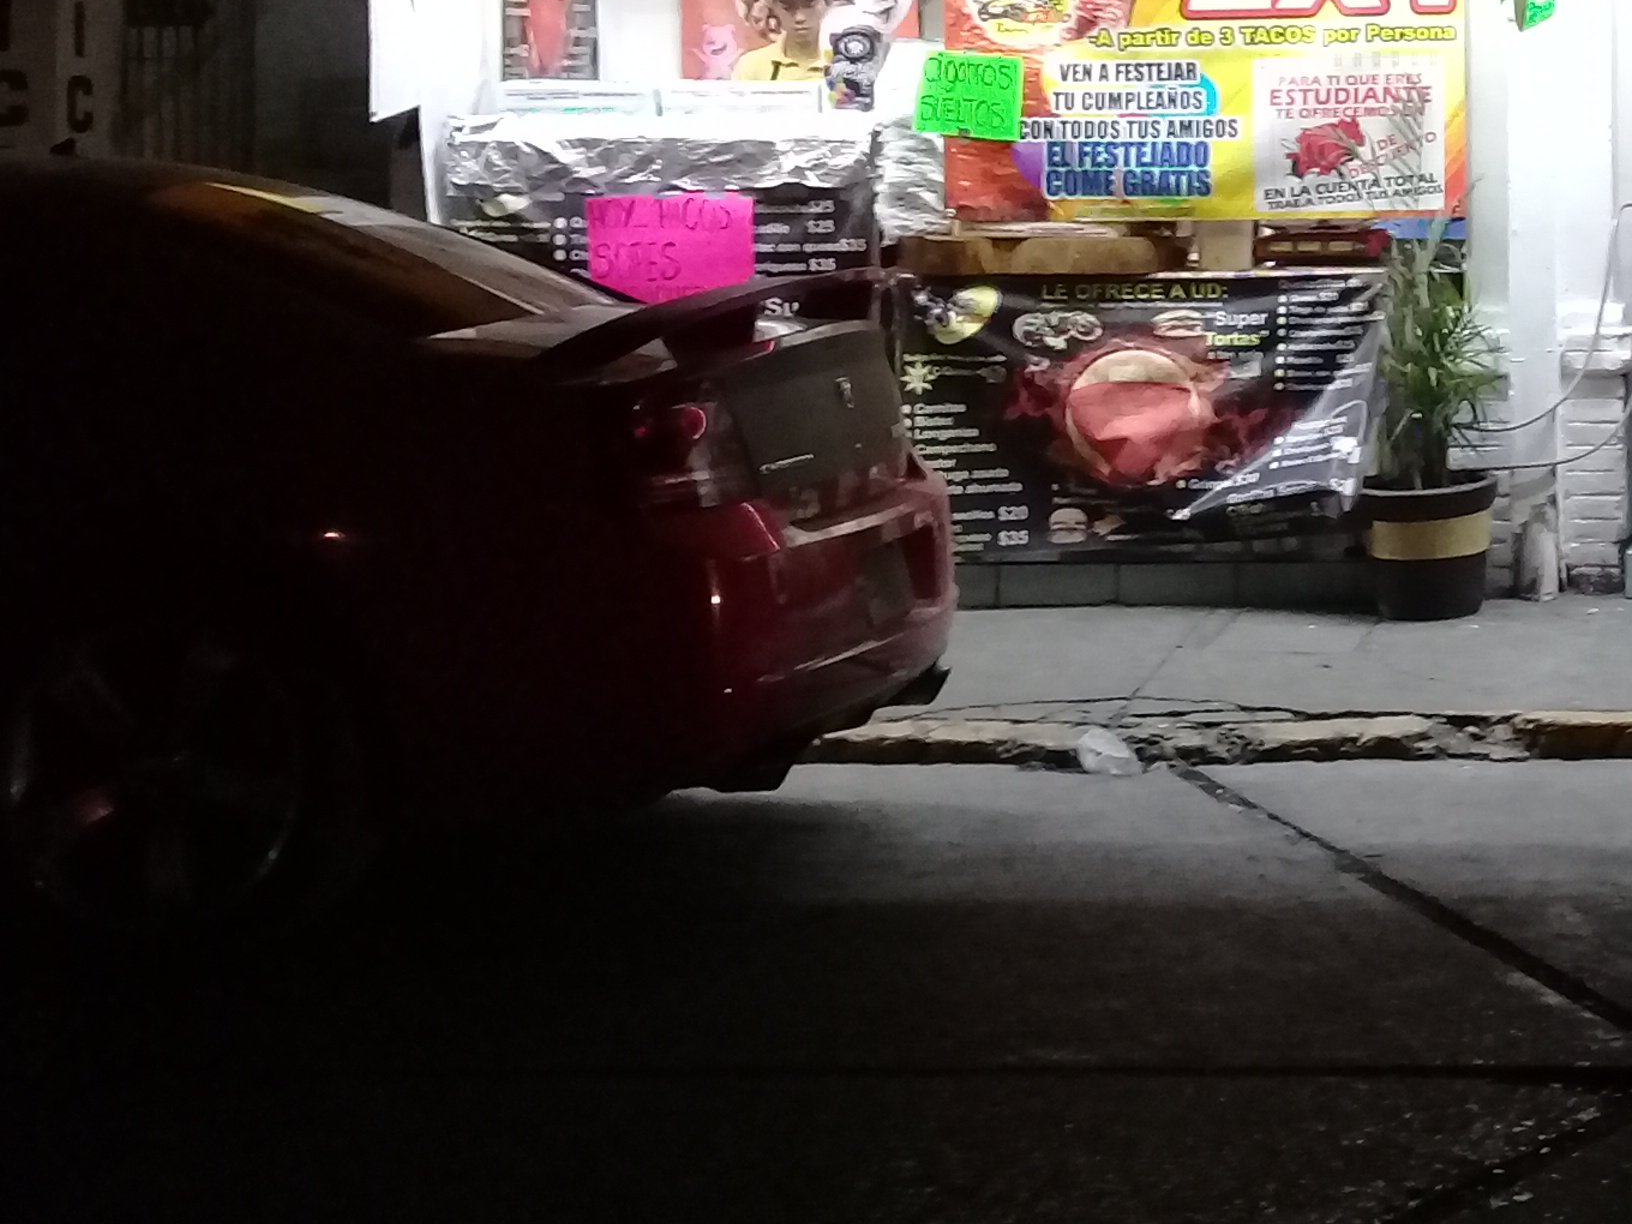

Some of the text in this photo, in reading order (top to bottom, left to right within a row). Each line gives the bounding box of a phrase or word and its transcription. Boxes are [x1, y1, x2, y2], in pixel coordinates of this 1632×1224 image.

[1117, 27, 1180, 52] partir
[1186, 26, 1215, 47] de
[1220, 25, 1235, 47] 3
[1239, 24, 1317, 46] TACOS
[1322, 27, 1361, 47] por
[1364, 22, 1457, 43] Persona
[1060, 61, 1197, 82] VEN A FESTEJAR
[1278, 76, 1321, 86] PARA
[1327, 75, 1340, 85] TI
[1345, 75, 1379, 86] QUE
[1053, 87, 1203, 111] TU CUMPLEAÑOS
[1269, 85, 1432, 106] ESTUDIANTE
[1019, 118, 1239, 140] CON TODOS TUS AMIGOS
[1046, 140, 1211, 169] EL FESTEJADO
[1045, 169, 1212, 197] COME GRATIS
[1264, 187, 1286, 200] EN
[1291, 186, 1311, 198] LA
[1042, 283, 1067, 299] LE
[1075, 281, 1165, 300] OFRECE
[1170, 281, 1188, 298] A
[1215, 310, 1269, 328] Super
[1205, 331, 1261, 347] Tortas
